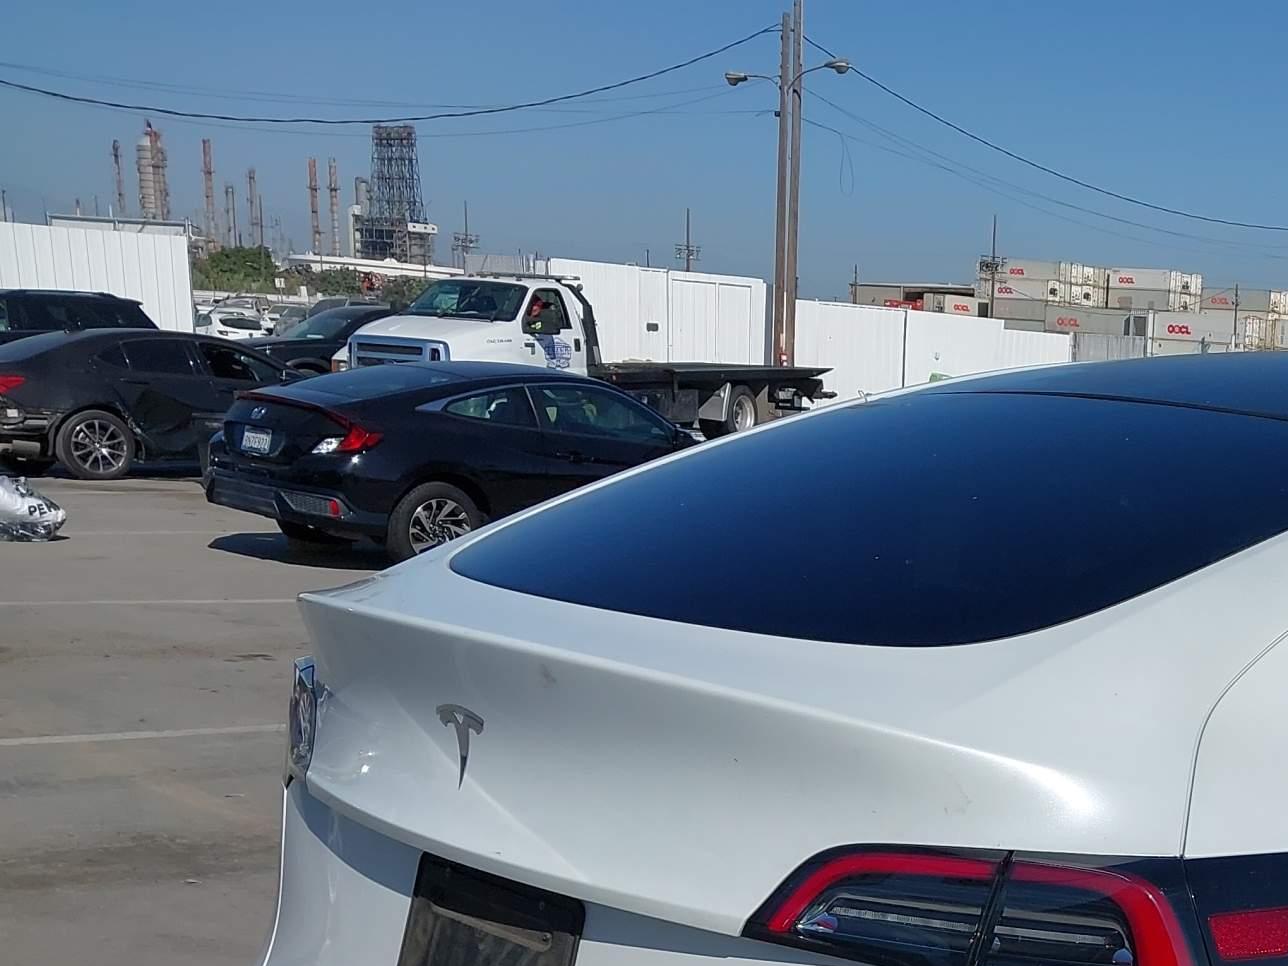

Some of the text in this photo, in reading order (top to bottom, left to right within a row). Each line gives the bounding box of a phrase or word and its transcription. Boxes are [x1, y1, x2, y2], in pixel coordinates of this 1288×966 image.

[1009, 268, 1025, 276] OOCL
[1118, 276, 1135, 284] OOCL
[1167, 324, 1191, 335] OOCL
